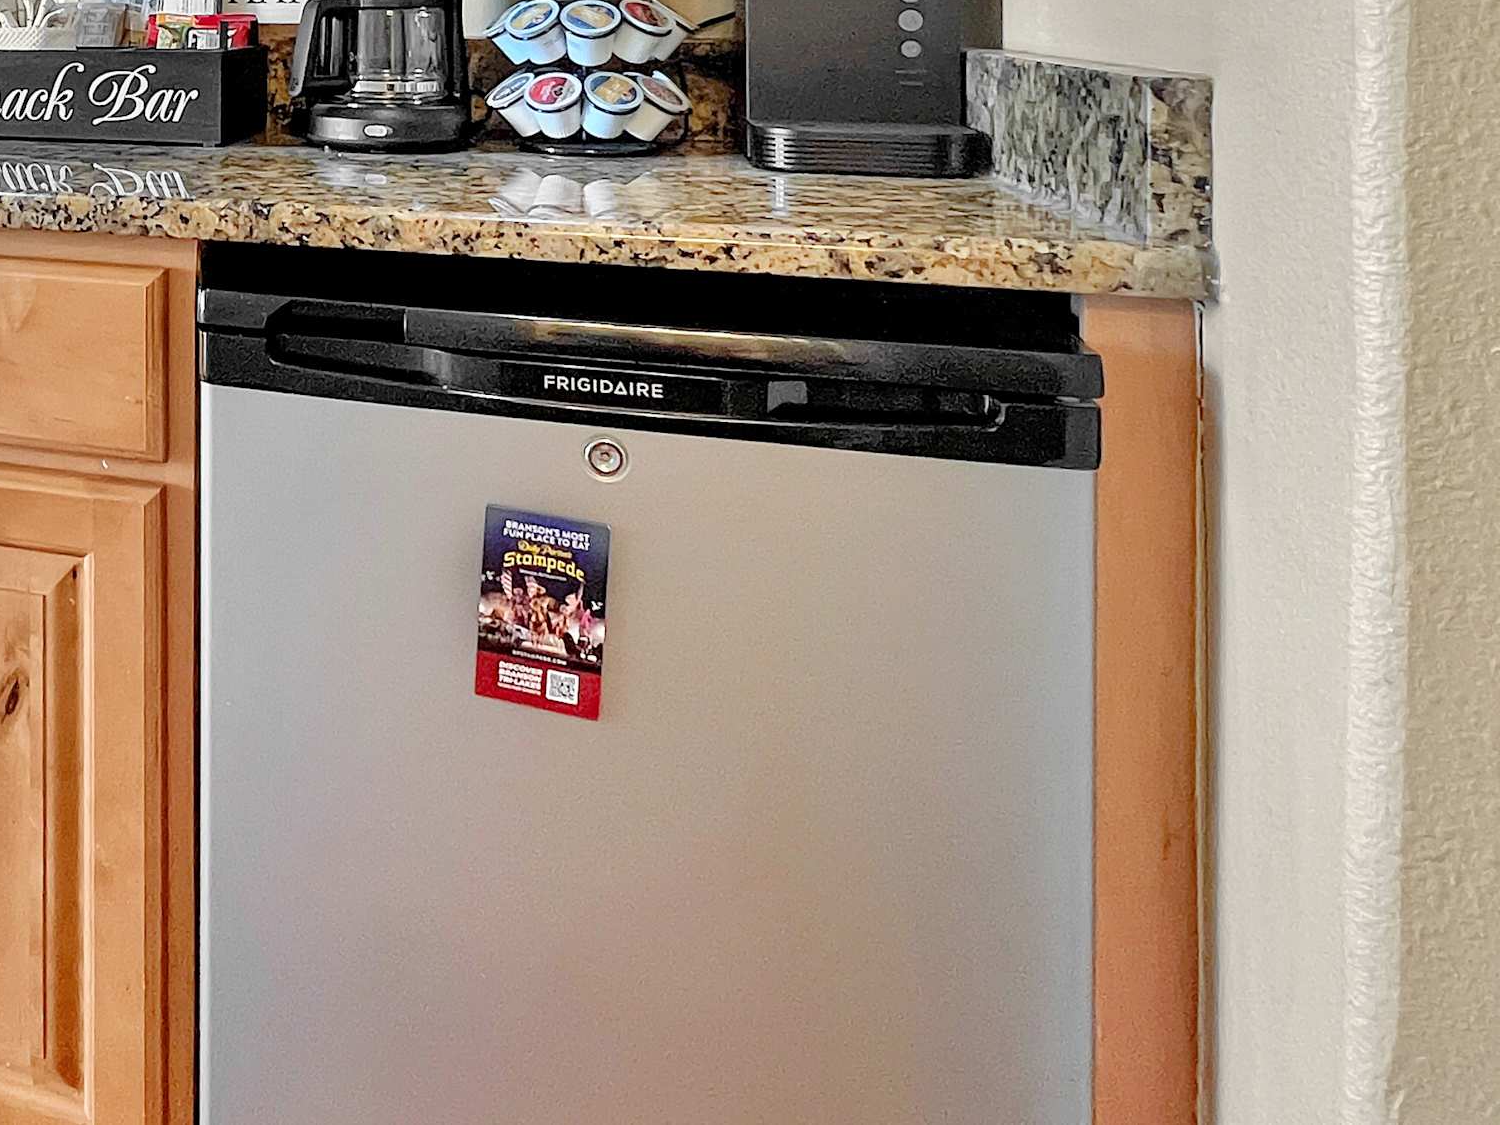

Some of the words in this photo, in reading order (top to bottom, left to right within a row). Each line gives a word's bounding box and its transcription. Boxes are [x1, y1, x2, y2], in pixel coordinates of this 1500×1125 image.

[88, 64, 199, 125] Bar
[543, 375, 664, 398] FRIGIDAIRE
[503, 528, 524, 538] FUN
[525, 532, 556, 545] PLACE
[557, 538, 571, 548] TO
[505, 520, 560, 537] BRANSON'S
[562, 530, 590, 543] MOST
[502, 551, 586, 584] Stampede
